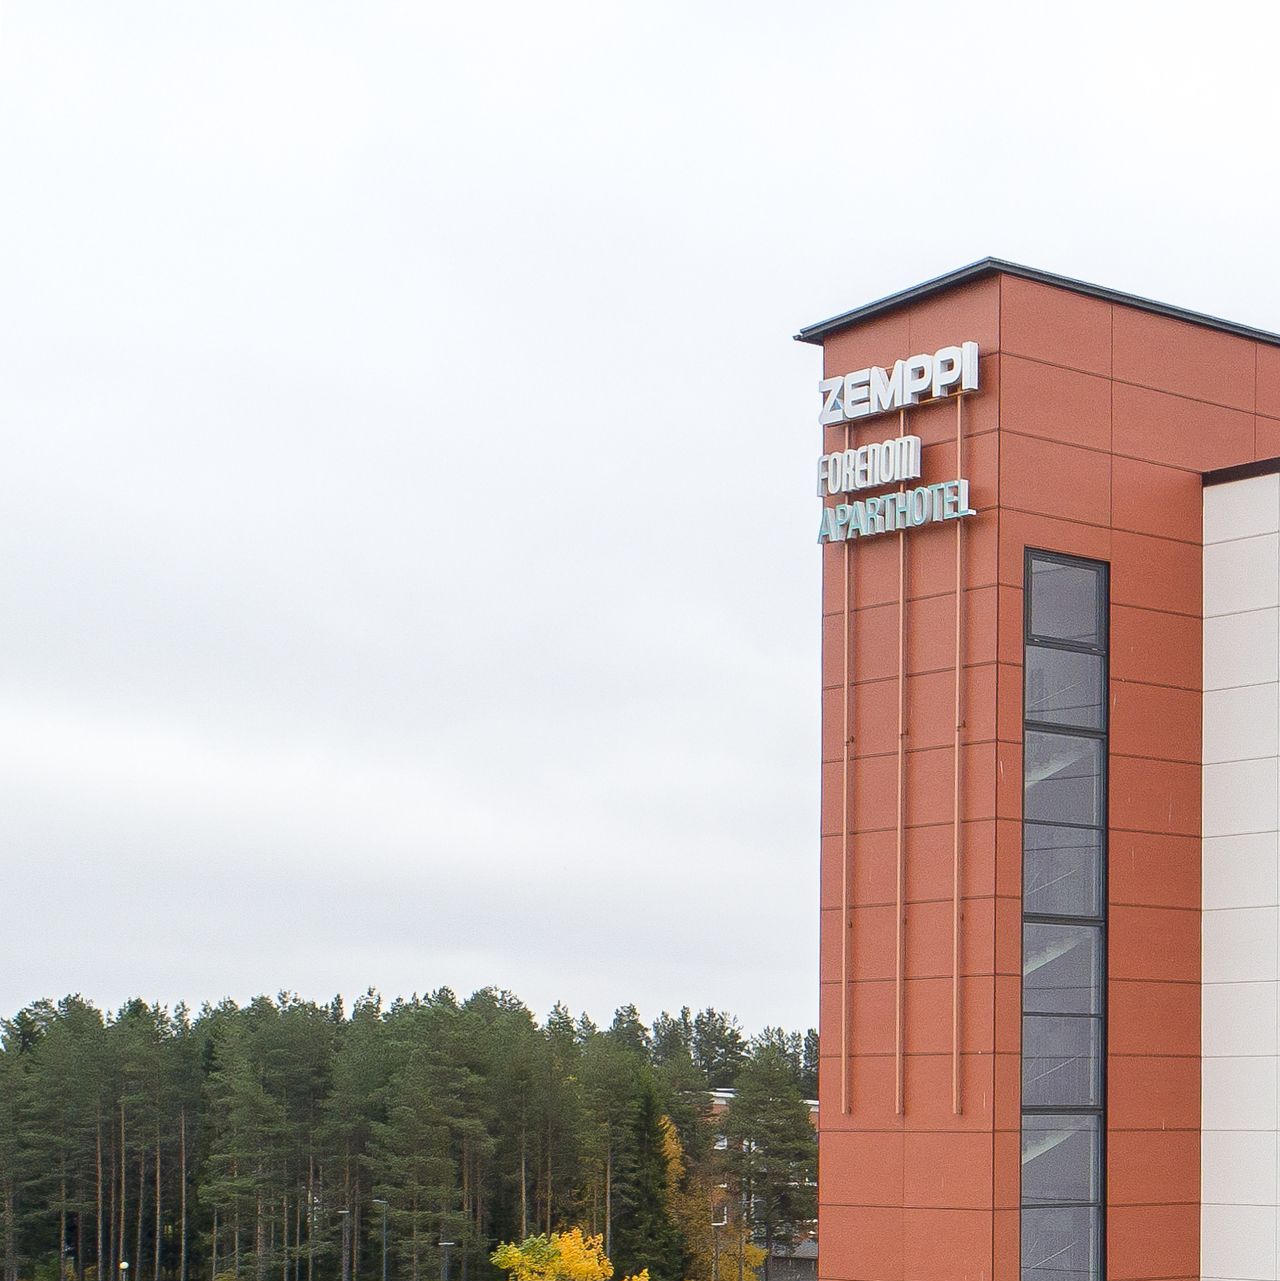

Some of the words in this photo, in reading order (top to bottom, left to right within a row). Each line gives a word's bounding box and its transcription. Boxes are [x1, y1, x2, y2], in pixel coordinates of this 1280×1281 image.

[819, 341, 979, 425] ZEMPPI
[817, 435, 921, 497] FORENOM
[817, 480, 974, 544] APARTHOTEL
